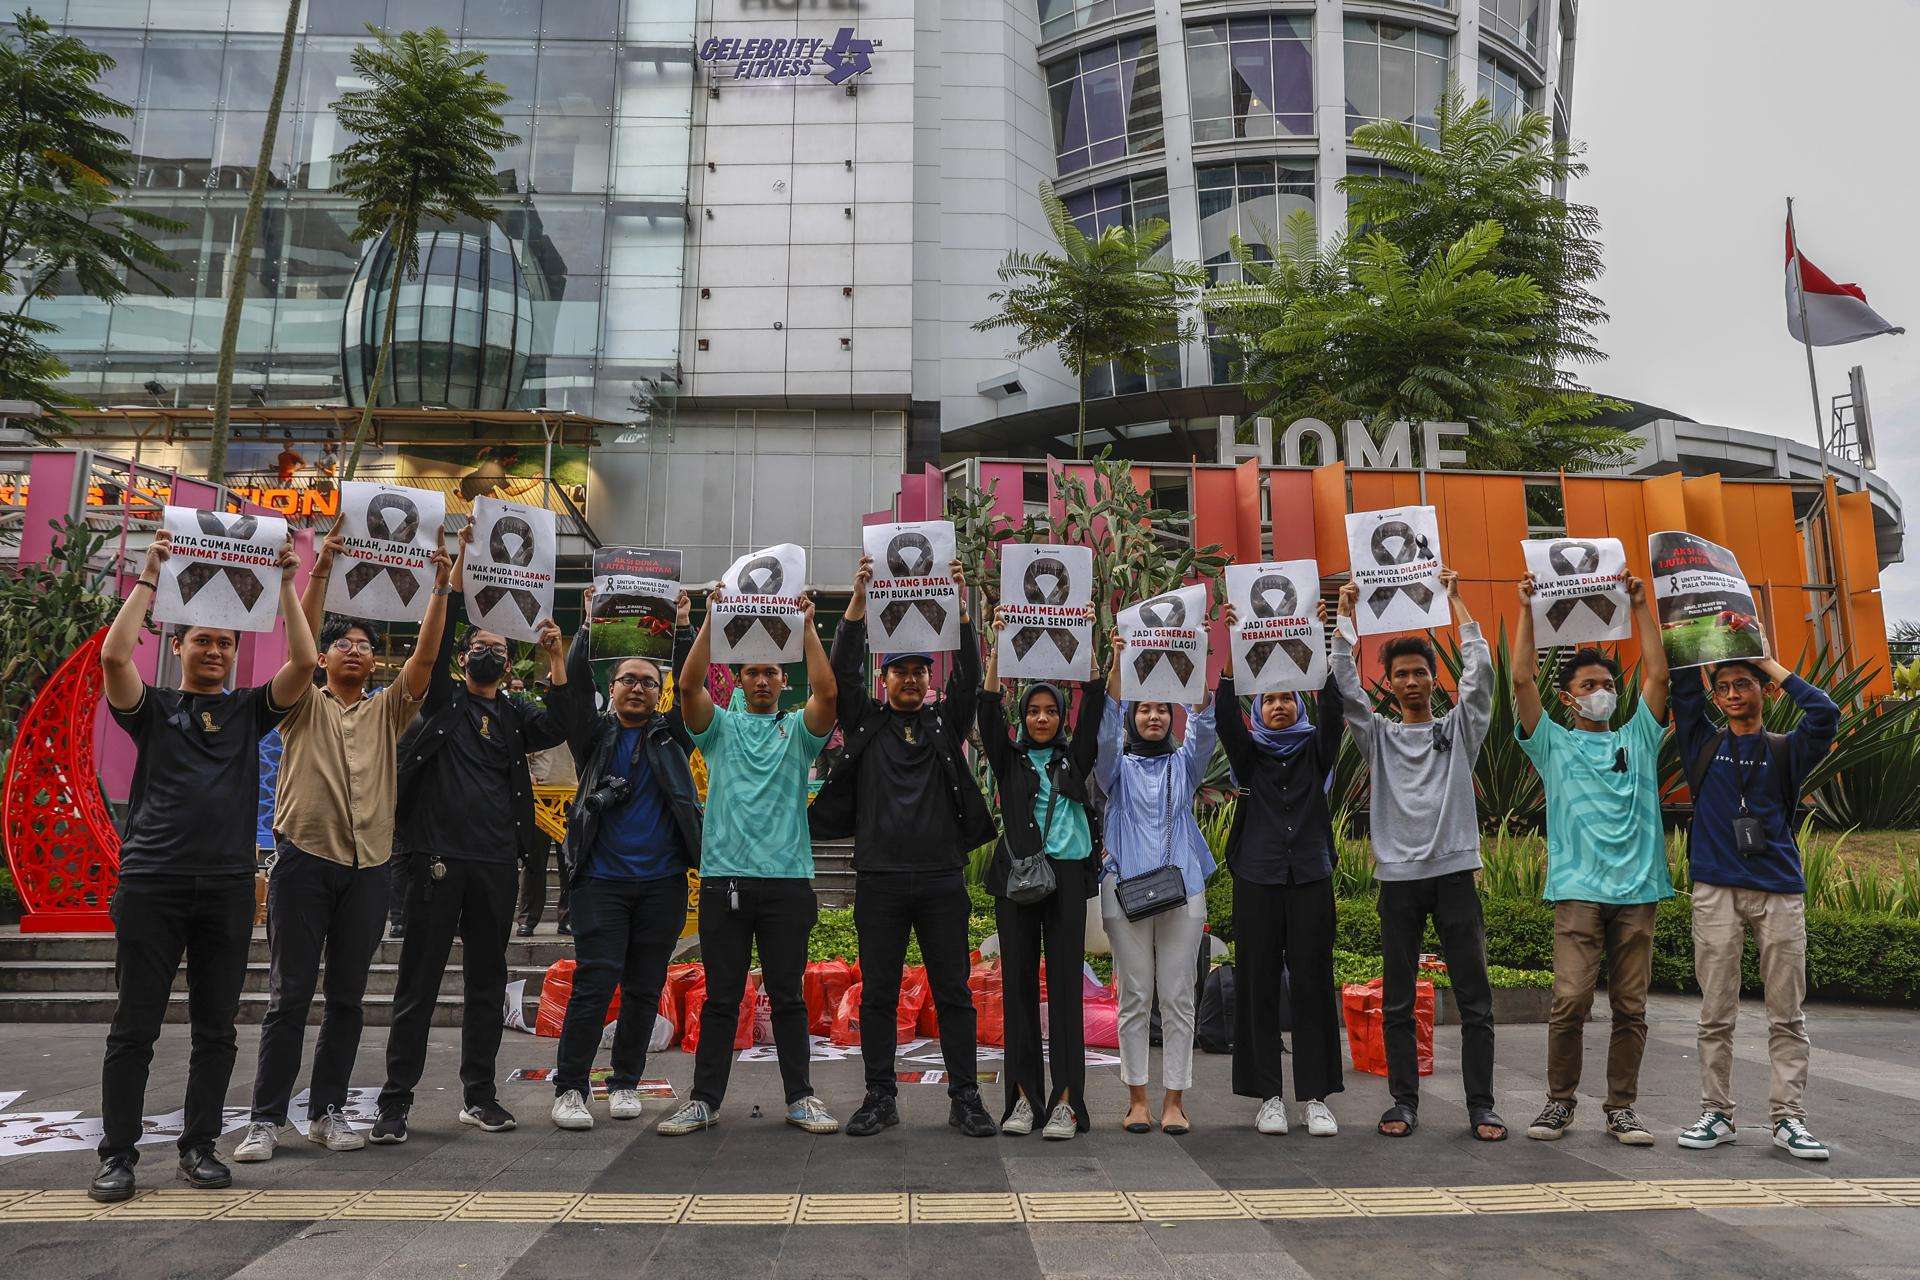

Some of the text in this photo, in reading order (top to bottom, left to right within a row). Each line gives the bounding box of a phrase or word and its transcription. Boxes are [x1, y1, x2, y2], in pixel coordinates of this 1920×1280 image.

[700, 38, 823, 61] CELEBRITY
[734, 59, 814, 80] FITNESS
[1217, 415, 1469, 469] HOME
[174, 535, 274, 557] KITA CUMA NEGARA
[384, 543, 408, 554] JADI
[405, 558, 424, 569] AJA
[1355, 560, 1438, 578] ANAK MUDA DILARANG
[466, 563, 551, 581] ANAK MUDA DILARANG
[1363, 570, 1432, 585] MIMPI KETINGGIAN
[473, 573, 544, 589] MIMPI KETINGGIAN
[637, 580, 657, 588] TIMNAS
[873, 576, 950, 589] ADA YANG BATAL
[1533, 581, 1555, 591] ANAK
[1556, 579, 1580, 588] MUDA
[1681, 575, 1702, 583] UNTUK
[1703, 575, 1725, 583] TIMNAS
[1541, 583, 1617, 599] MIMPI KETINGGIAN
[1682, 582, 1699, 590] PIALA
[869, 587, 955, 600] TAPI BUKAN PUASA
[722, 595, 800, 608] ALAH MELAWAN
[716, 604, 757, 614] BANGSA
[1003, 604, 1036, 615] KALAH
[1004, 614, 1087, 627] BANGSA SENDIRI
[1243, 616, 1309, 630] JADI GENERASI
[1132, 629, 1196, 639] JADI GENERASI
[1241, 626, 1312, 641] REBAHAN (LAGI)
[1130, 639, 1197, 650] REBAHAN (LAGI)
